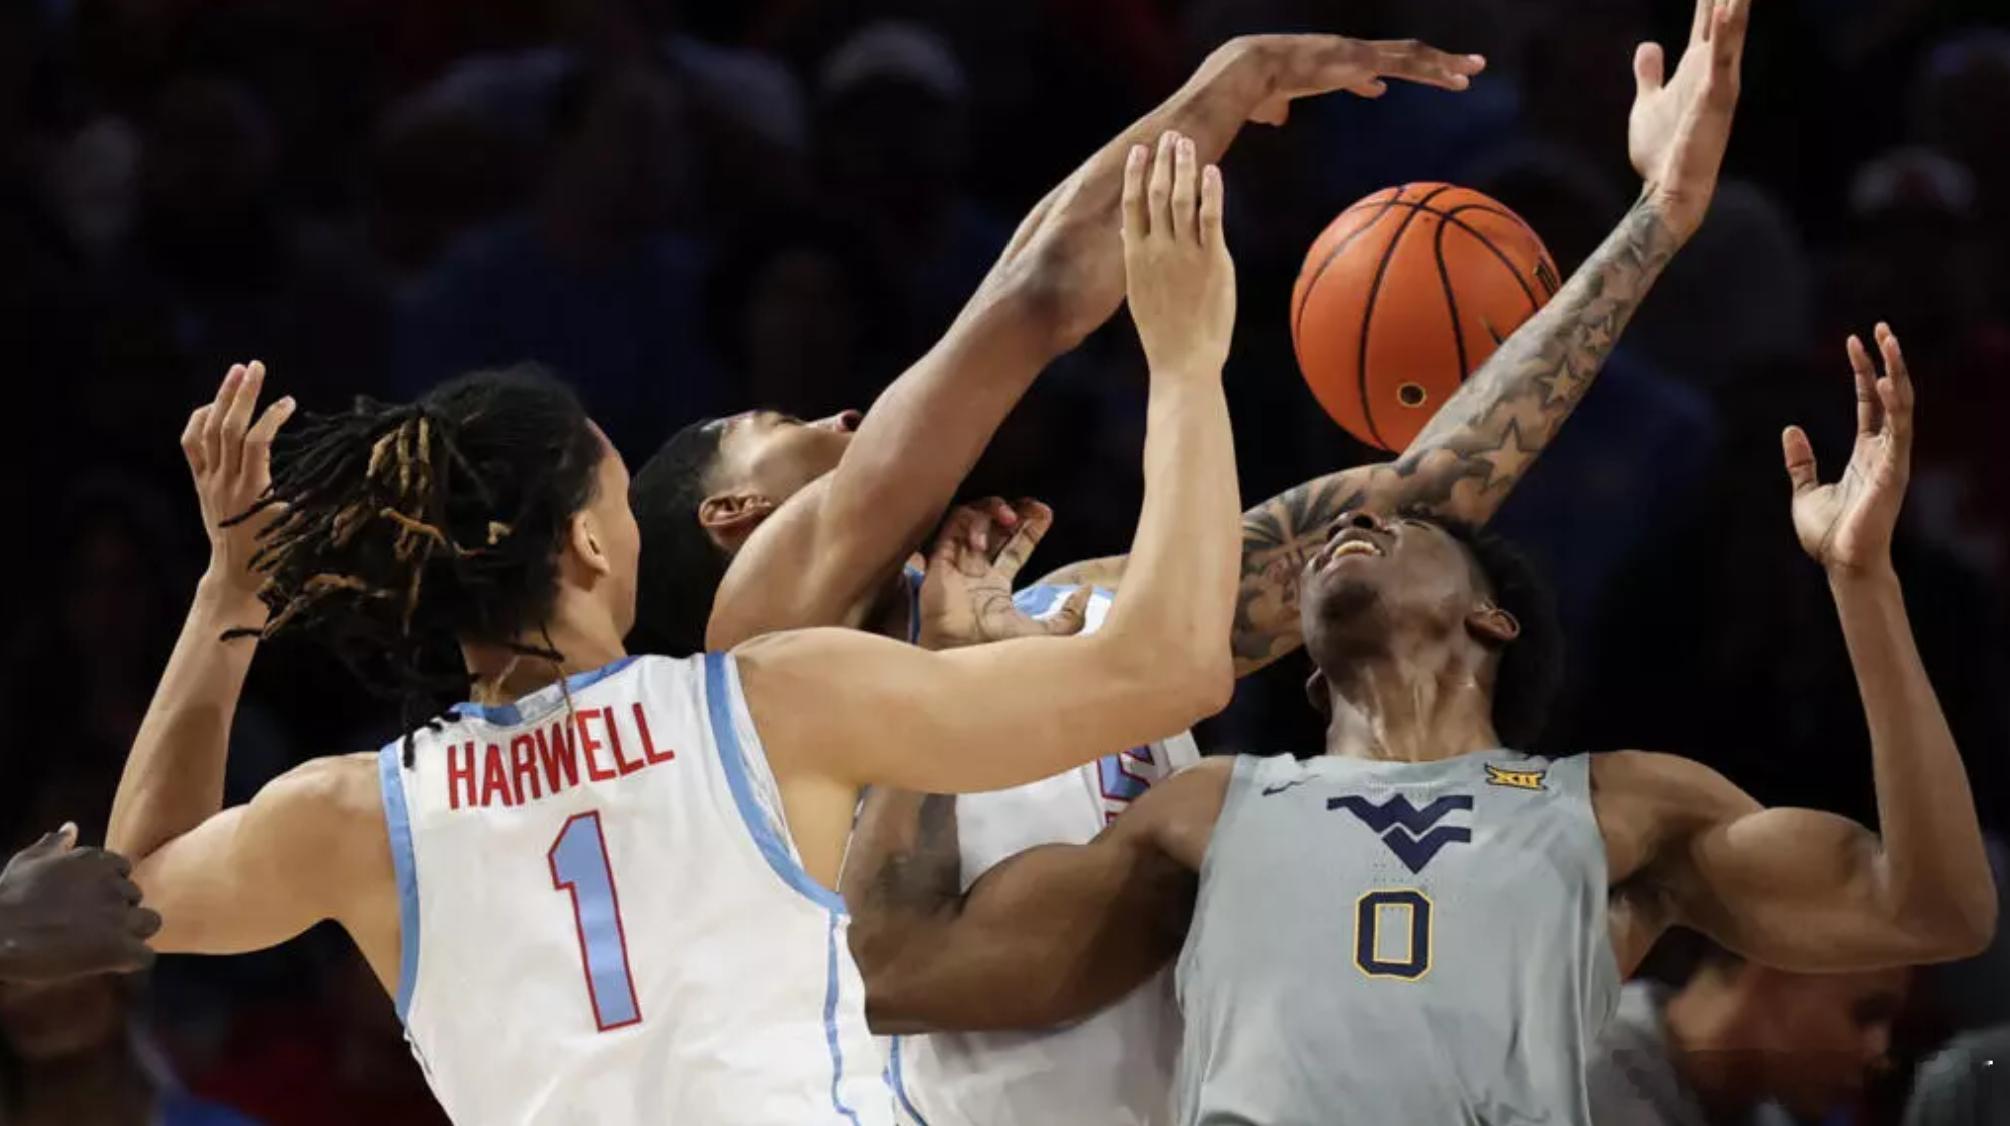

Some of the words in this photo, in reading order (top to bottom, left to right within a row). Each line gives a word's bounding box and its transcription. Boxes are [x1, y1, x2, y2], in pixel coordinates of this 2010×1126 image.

[447, 702, 675, 810] HARWELL
[548, 810, 642, 1032] 1
[1354, 887, 1434, 982] 0
